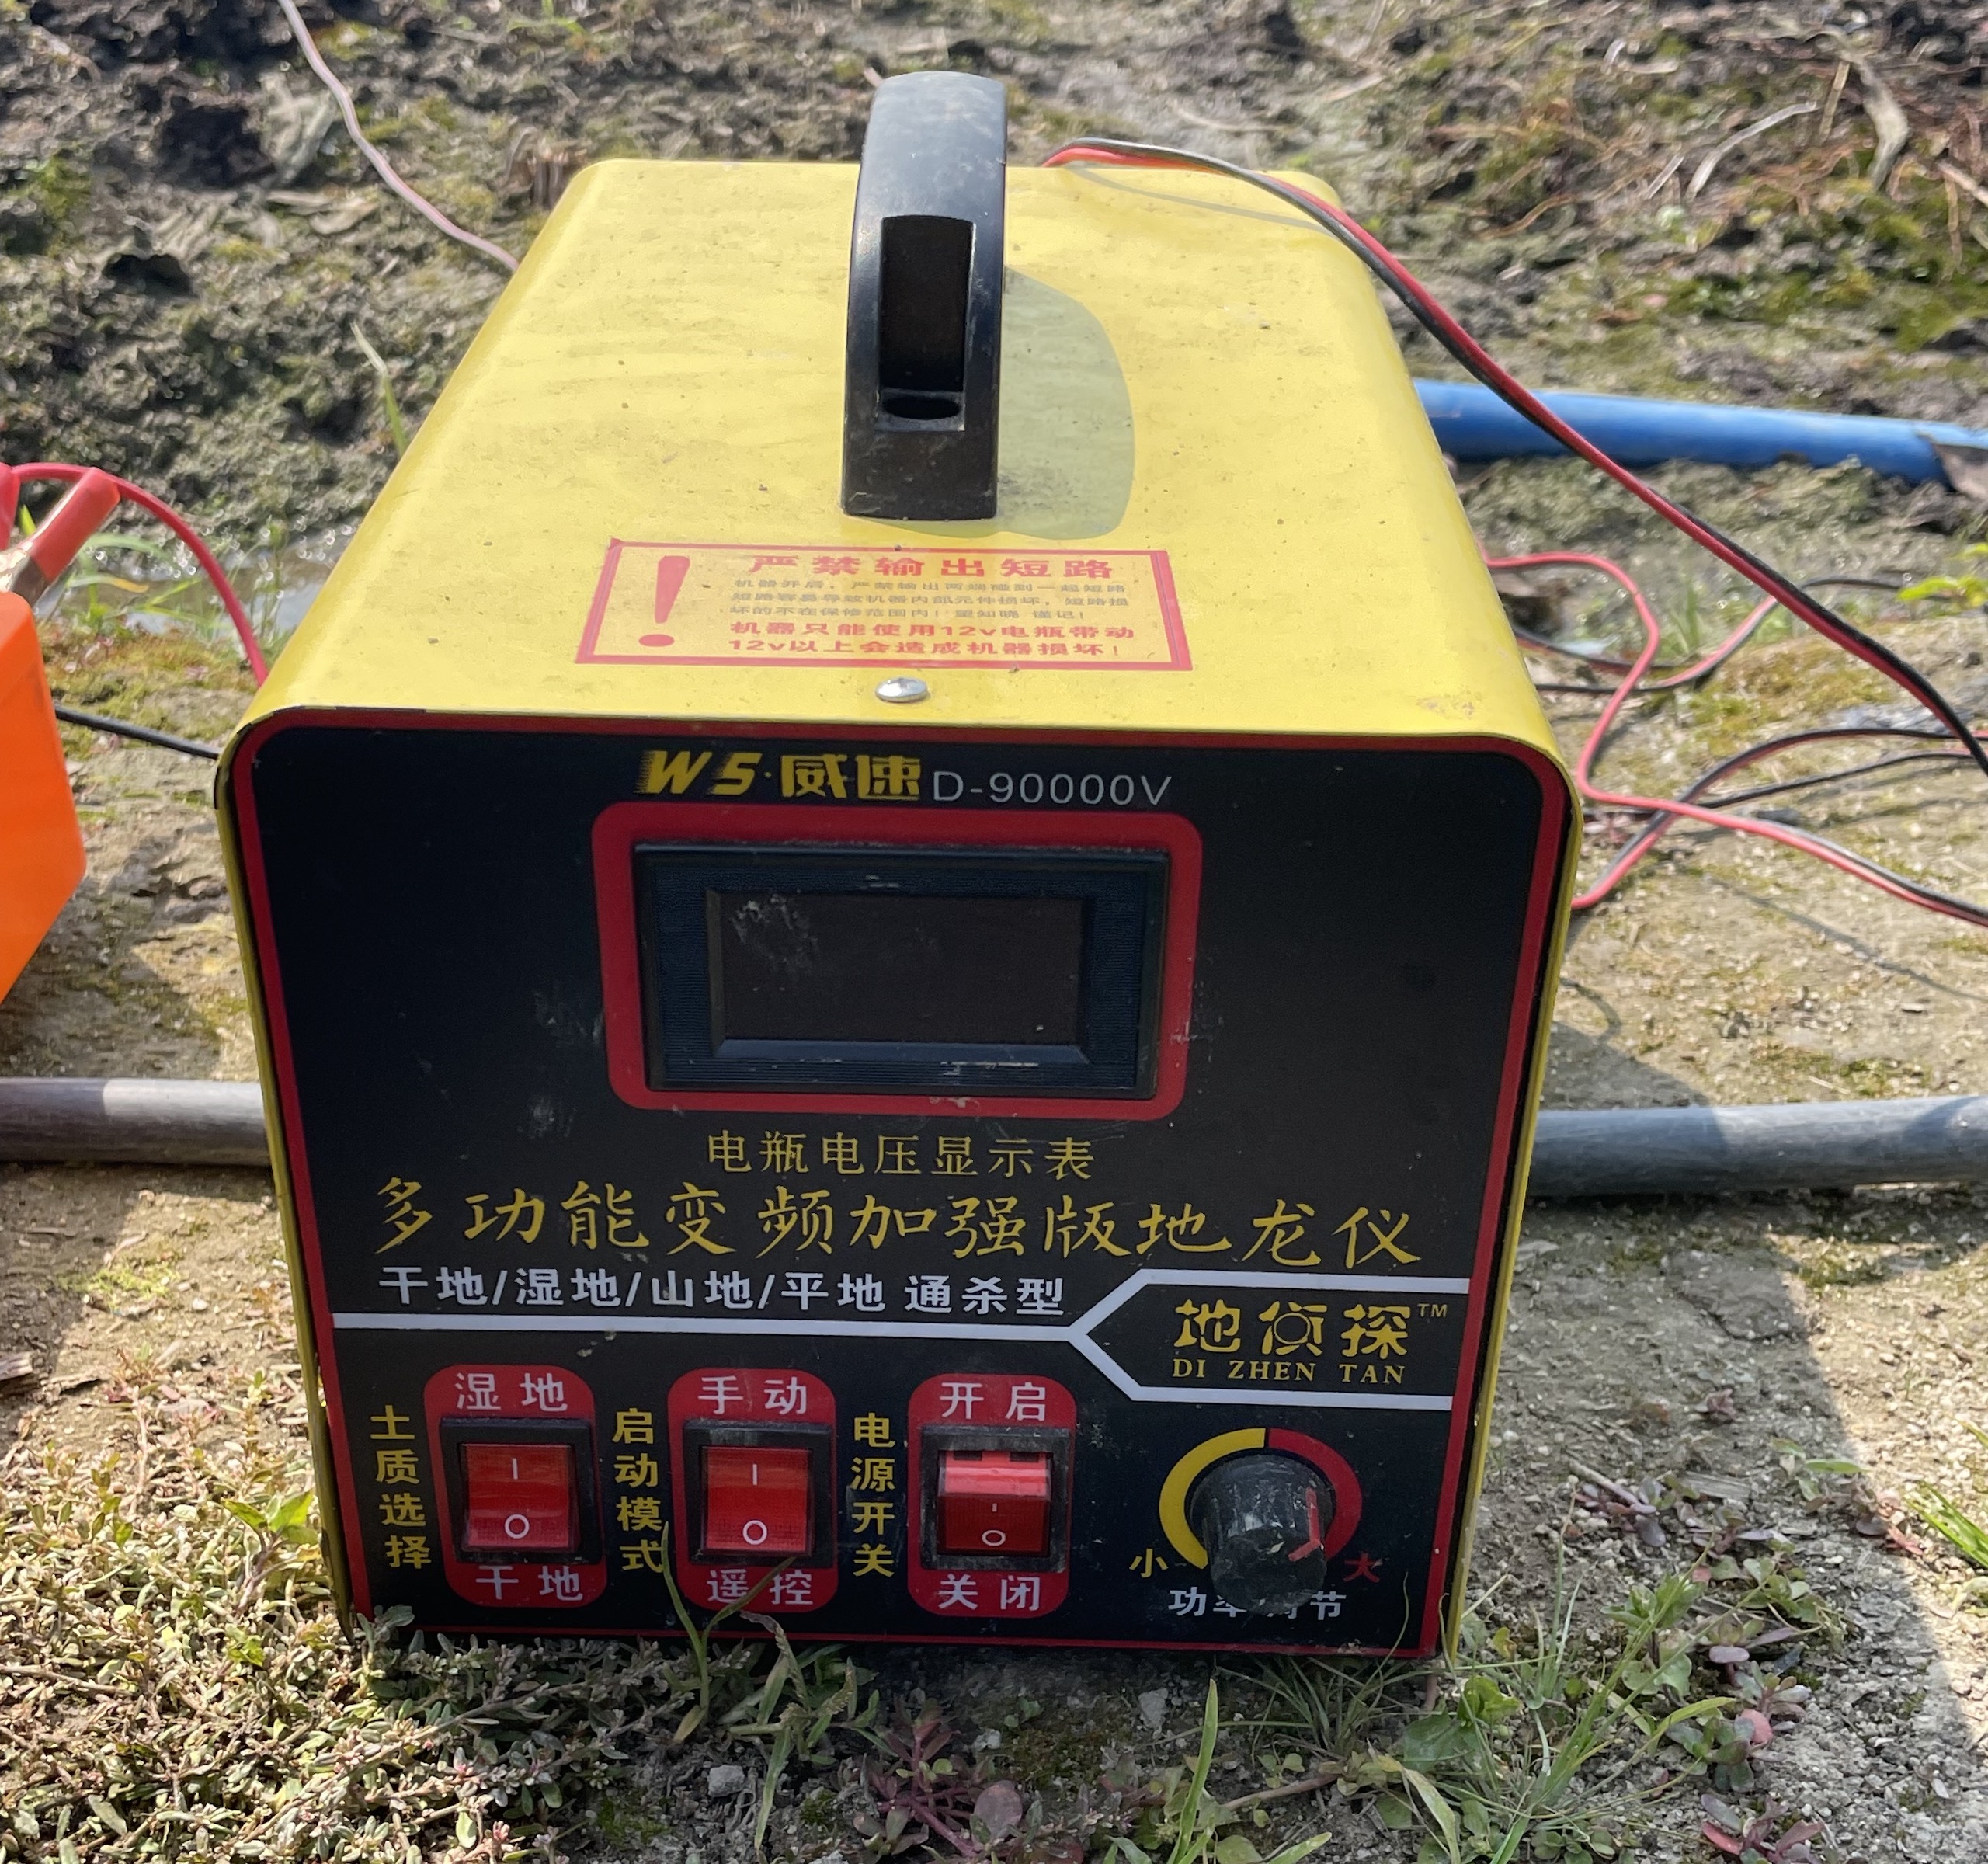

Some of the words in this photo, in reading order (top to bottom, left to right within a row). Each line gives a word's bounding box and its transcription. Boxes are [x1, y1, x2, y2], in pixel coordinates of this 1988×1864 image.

[748, 555, 1113, 579] 严禁输出短路
[730, 621, 1135, 639] 机器只能使用12v电瓶带动
[933, 770, 1171, 805] D-90000V
[707, 1130, 1094, 1181] 电瓶电压显示表
[374, 1176, 1421, 1269] 多功能变频加强版地龙仪
[379, 1266, 887, 1312] 干地/湿地/山地/平地
[904, 1274, 1065, 1316] 通杀型
[1173, 1299, 1410, 1359] 地侦探
[1173, 1358, 1205, 1379] DI
[1228, 1360, 1316, 1382] ZHEN
[1340, 1363, 1406, 1384] TAN
[455, 1372, 568, 1413] 湿地
[698, 1375, 807, 1415] 手动
[940, 1382, 1046, 1421] 开启
[370, 1404, 432, 1570] 土质选择
[612, 1408, 665, 1574] 启动模式
[850, 1412, 895, 1577] 电源开关
[1129, 1548, 1169, 1577] 小
[1343, 1553, 1382, 1583] 大
[475, 1565, 584, 1601] 干地
[707, 1569, 813, 1605] 遥控
[938, 1574, 1041, 1611] 关闭
